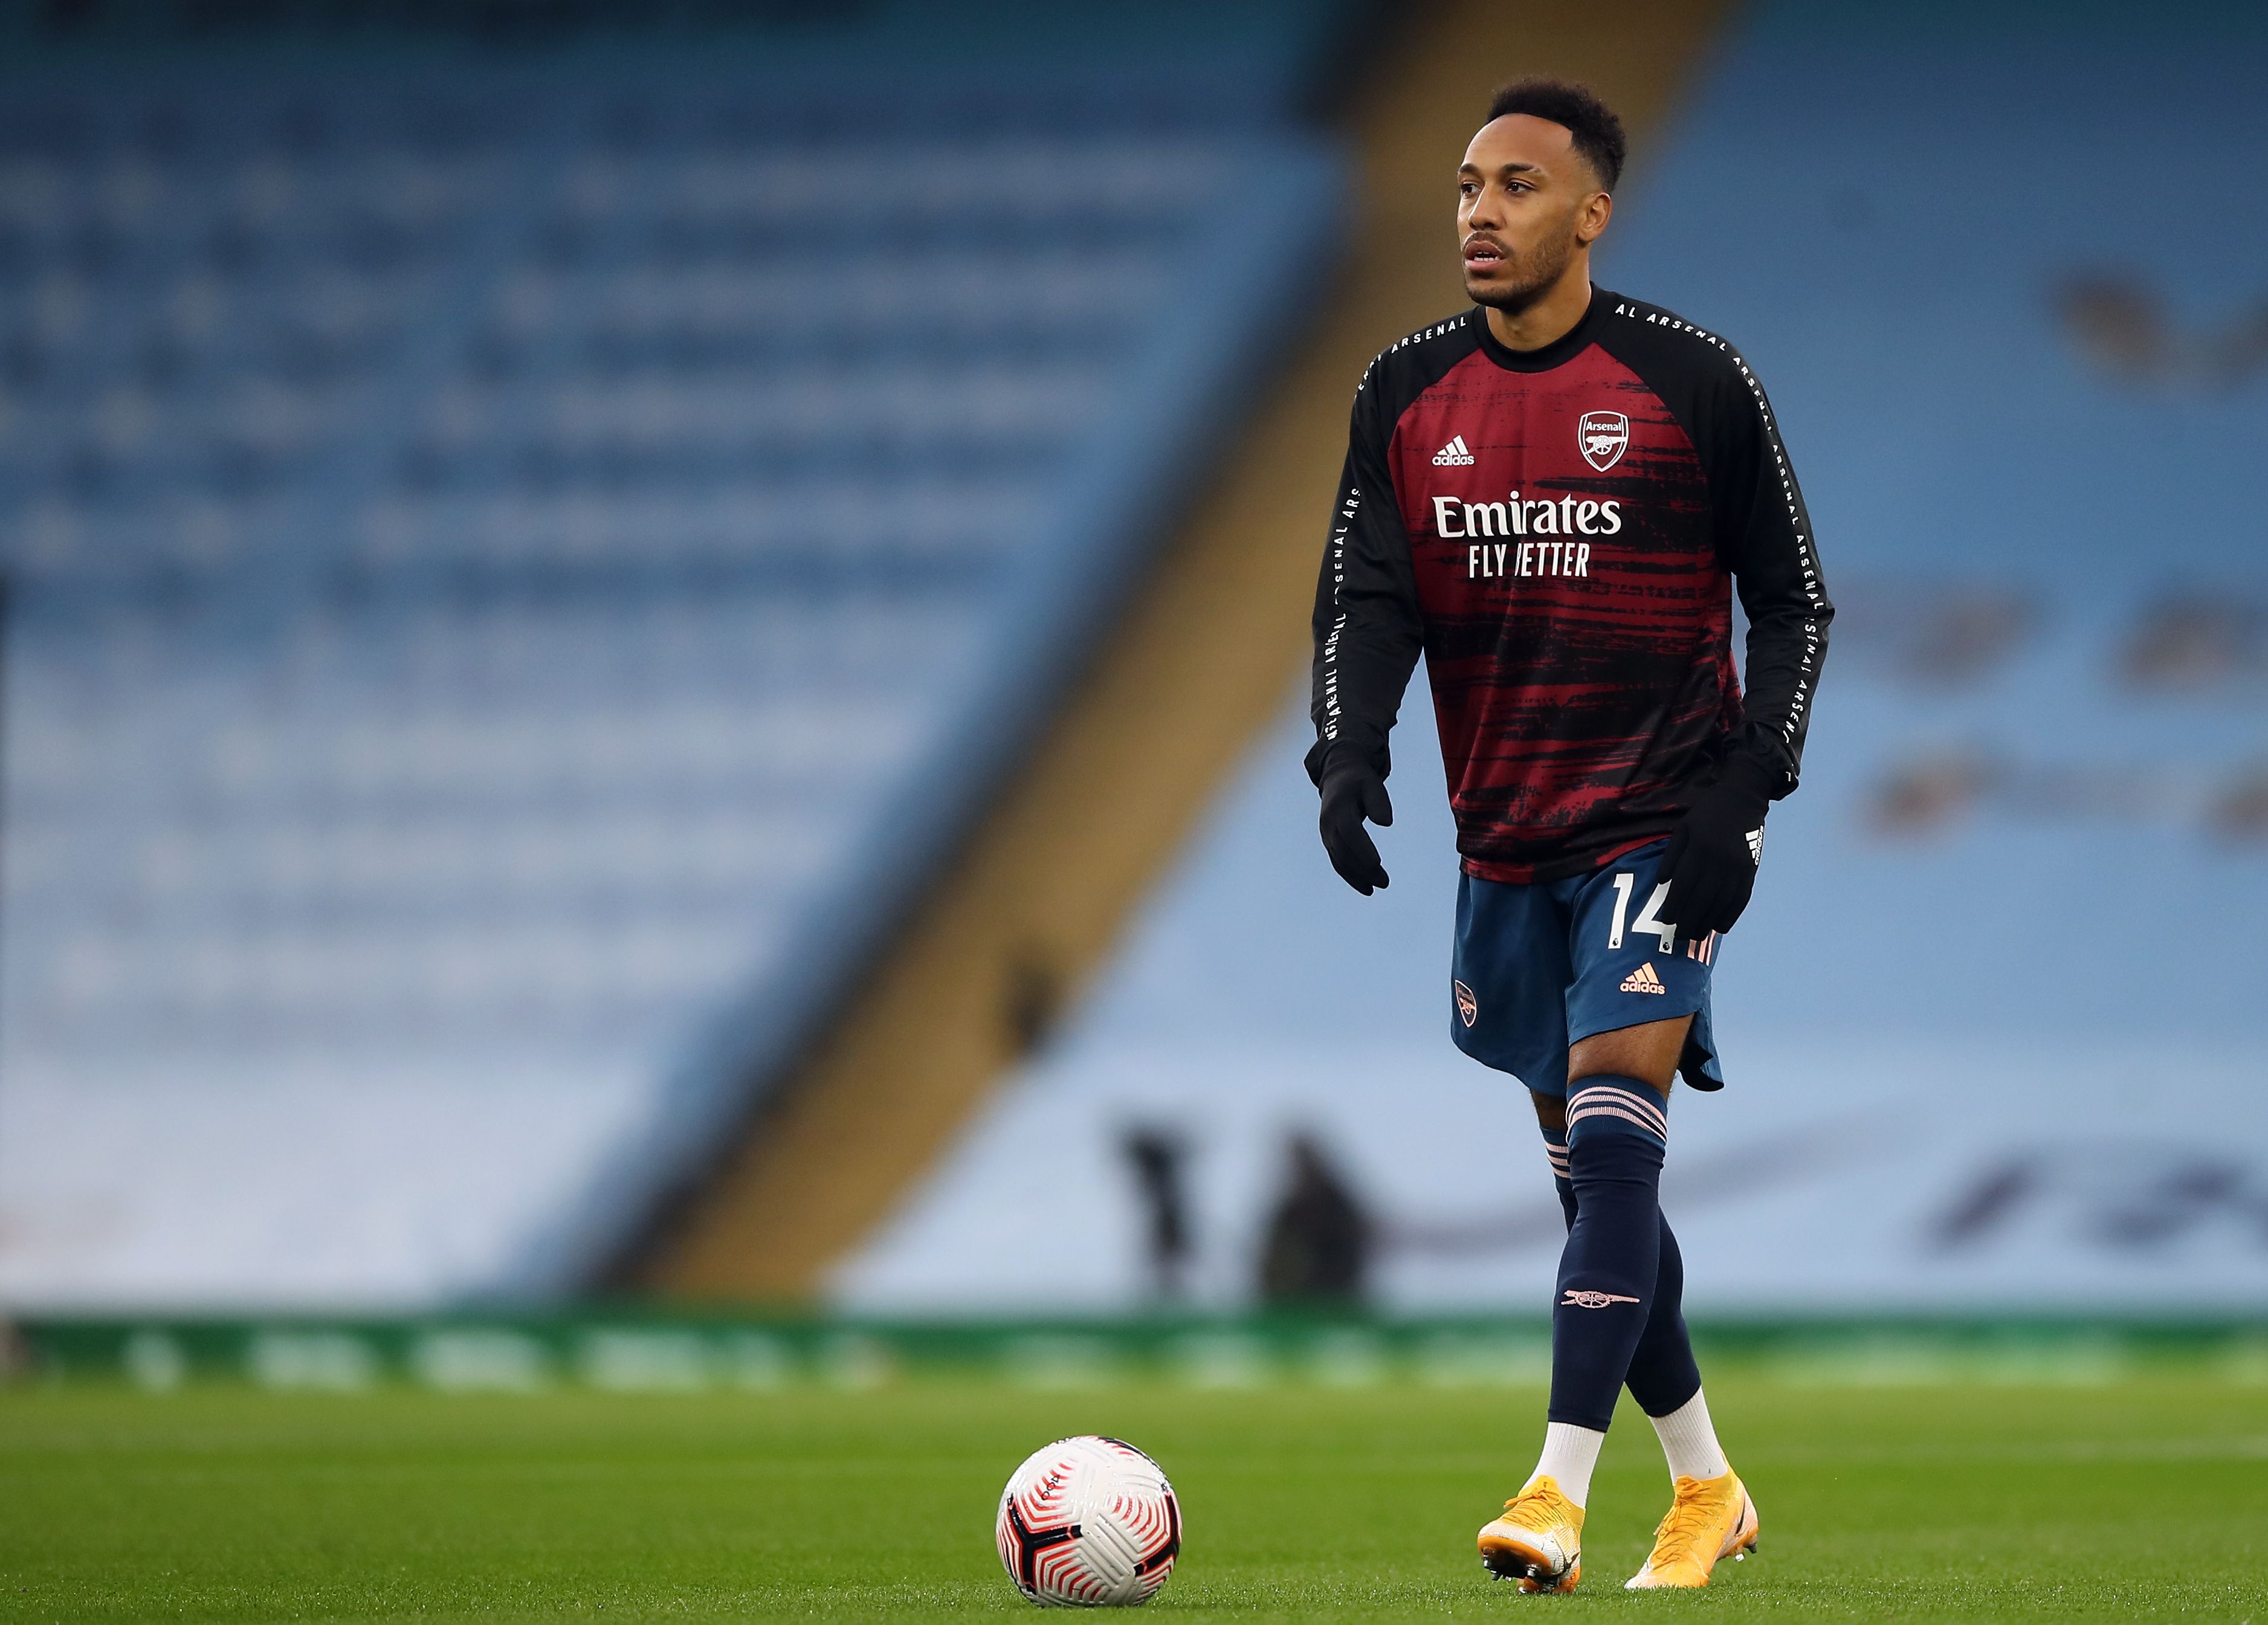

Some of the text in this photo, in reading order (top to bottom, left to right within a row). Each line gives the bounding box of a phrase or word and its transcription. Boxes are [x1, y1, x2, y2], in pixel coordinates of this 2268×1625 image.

[1391, 317, 1466, 354] ARSENAL
[1646, 314, 1727, 351] ARSENAL
[1586, 421, 1621, 431] Arsenal
[1432, 454, 1475, 466] adidas
[1773, 445, 1798, 525] ARSENAL
[1431, 490, 1621, 538] Emirates
[1334, 527, 1348, 605] SENAL
[1470, 544, 1507, 578] FLY
[1797, 535, 1824, 609] ARSENAL
[1325, 613, 1346, 663] AREAL
[1801, 617, 1818, 672] SENAL
[1325, 668, 1342, 716] ARNAL
[1608, 873, 1677, 954] 14
[1620, 981, 1665, 995] adidas
